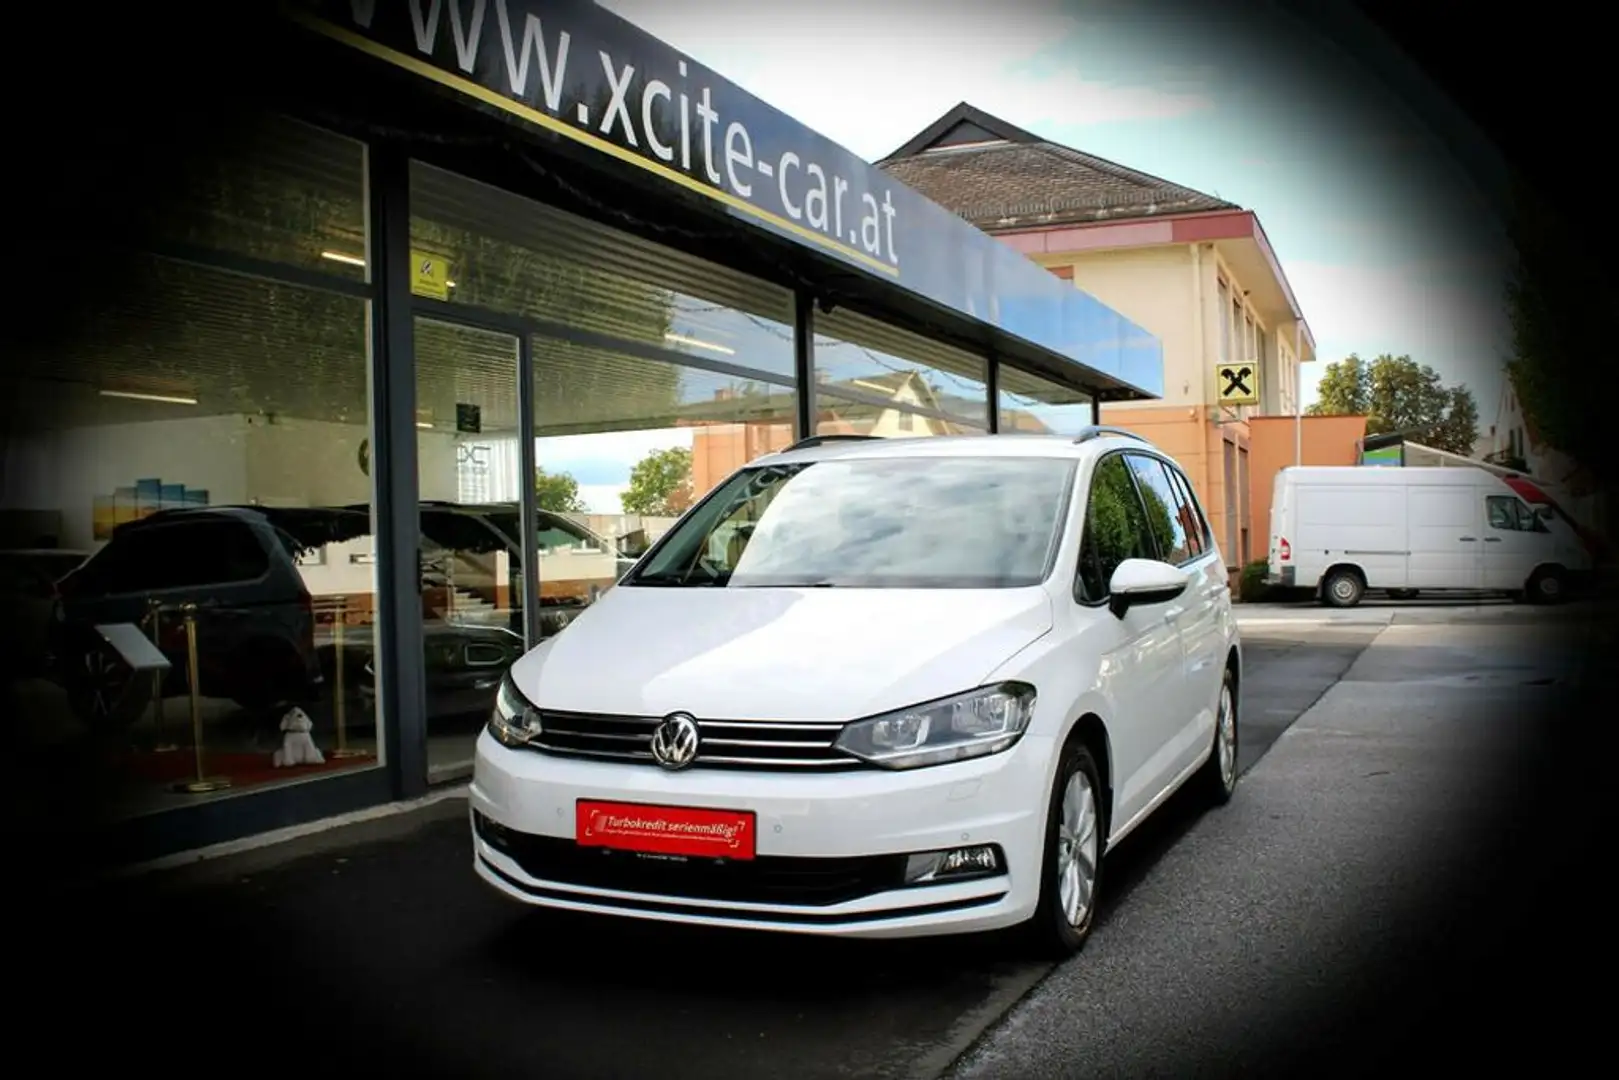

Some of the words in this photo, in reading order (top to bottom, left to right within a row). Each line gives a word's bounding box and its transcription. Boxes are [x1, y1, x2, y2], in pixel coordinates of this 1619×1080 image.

[351, 0, 898, 263] ww.xcite-car.at
[608, 815, 666, 831] Turbokredit
[667, 821, 738, 838] serienmäßig!
